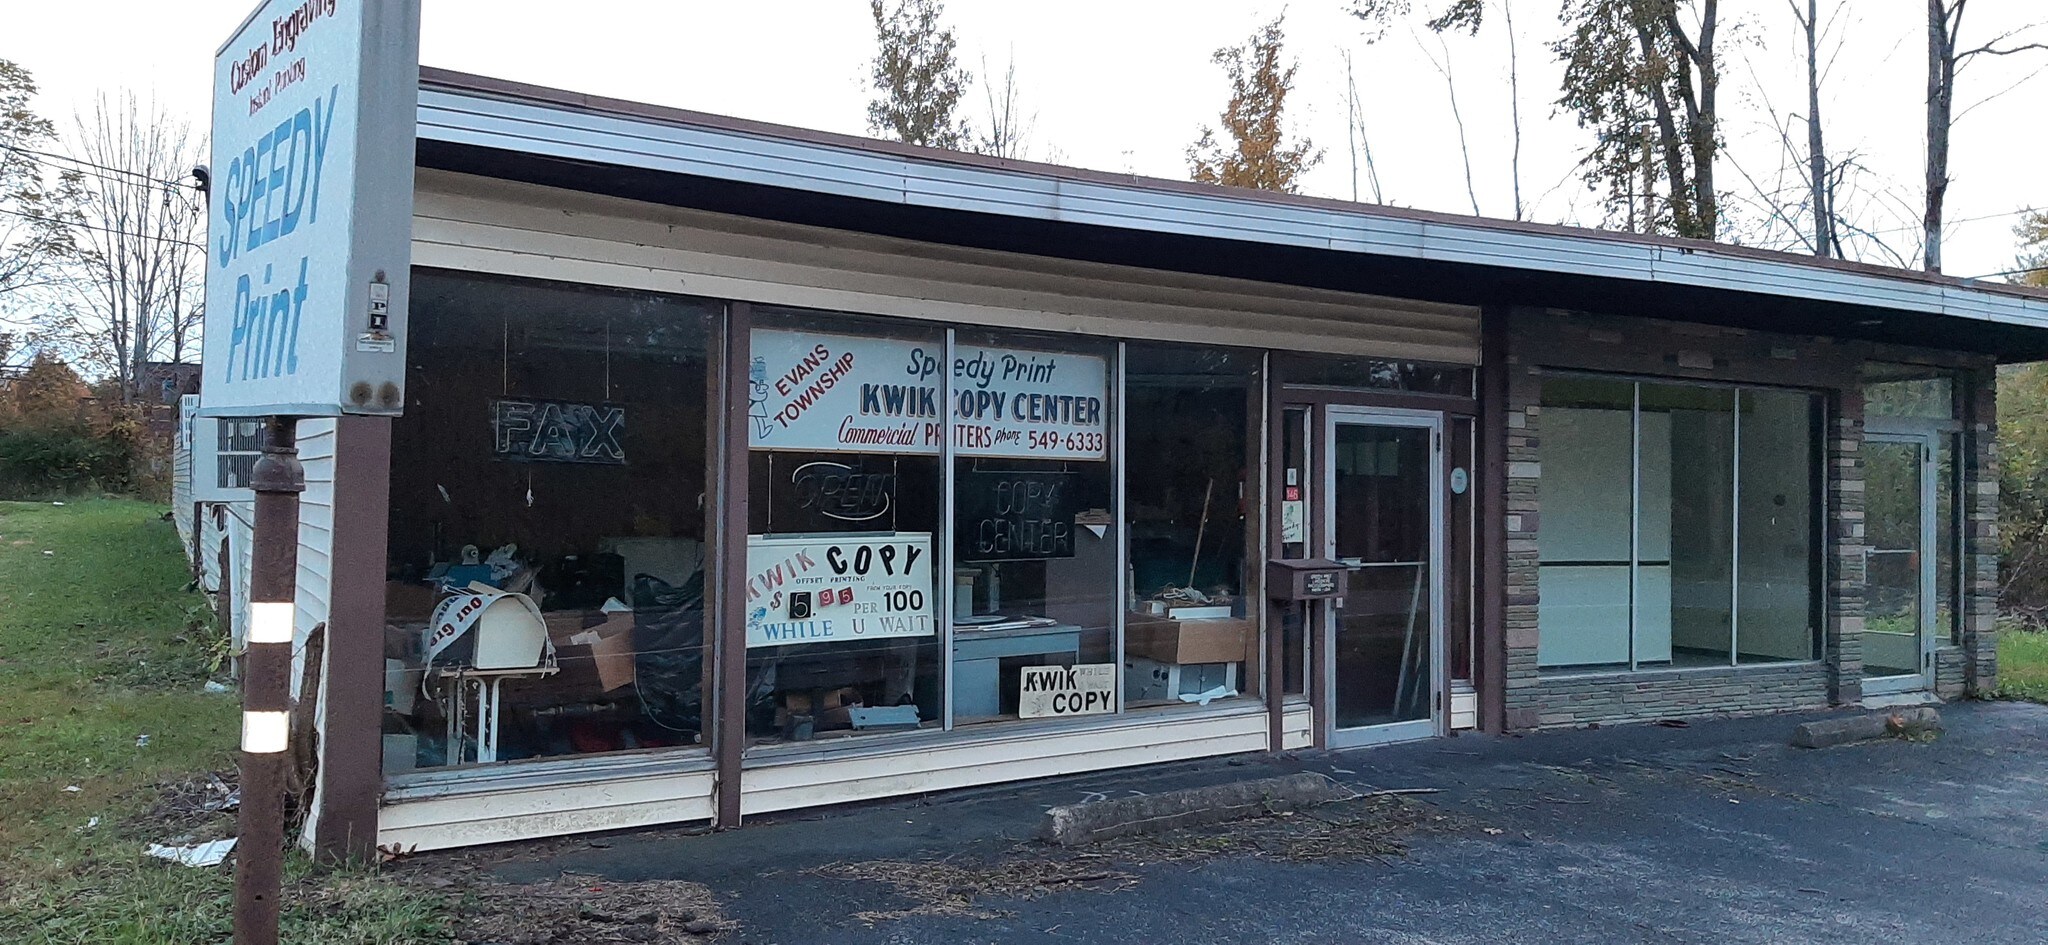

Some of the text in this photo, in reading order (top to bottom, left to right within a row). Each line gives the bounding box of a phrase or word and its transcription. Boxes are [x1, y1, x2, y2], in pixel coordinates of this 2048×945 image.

[231, 41, 268, 95] Custom
[219, 84, 339, 268] SPEEDY
[225, 256, 308, 384] Print
[775, 344, 830, 397] EVANS
[906, 348, 1056, 389] Spedy Print
[773, 352, 854, 429] TOWNSHIP
[860, 383, 936, 418] KWIK
[1012, 392, 1101, 426] CENTER
[496, 402, 625, 459] FAX
[838, 415, 1103, 452] Commercial PRTERS phone 549-6333
[794, 474, 889, 509] OPEN
[996, 481, 1058, 515] COPY
[979, 519, 1068, 554] CENTER
[746, 545, 922, 603] KWIK COPY
[795, 575, 866, 585] OFFSET PRINTING
[854, 590, 924, 614] PER 100
[763, 615, 929, 641] WHILE U WAIT
[1024, 670, 1077, 692] KWIK
[1052, 690, 1111, 714] COPY
